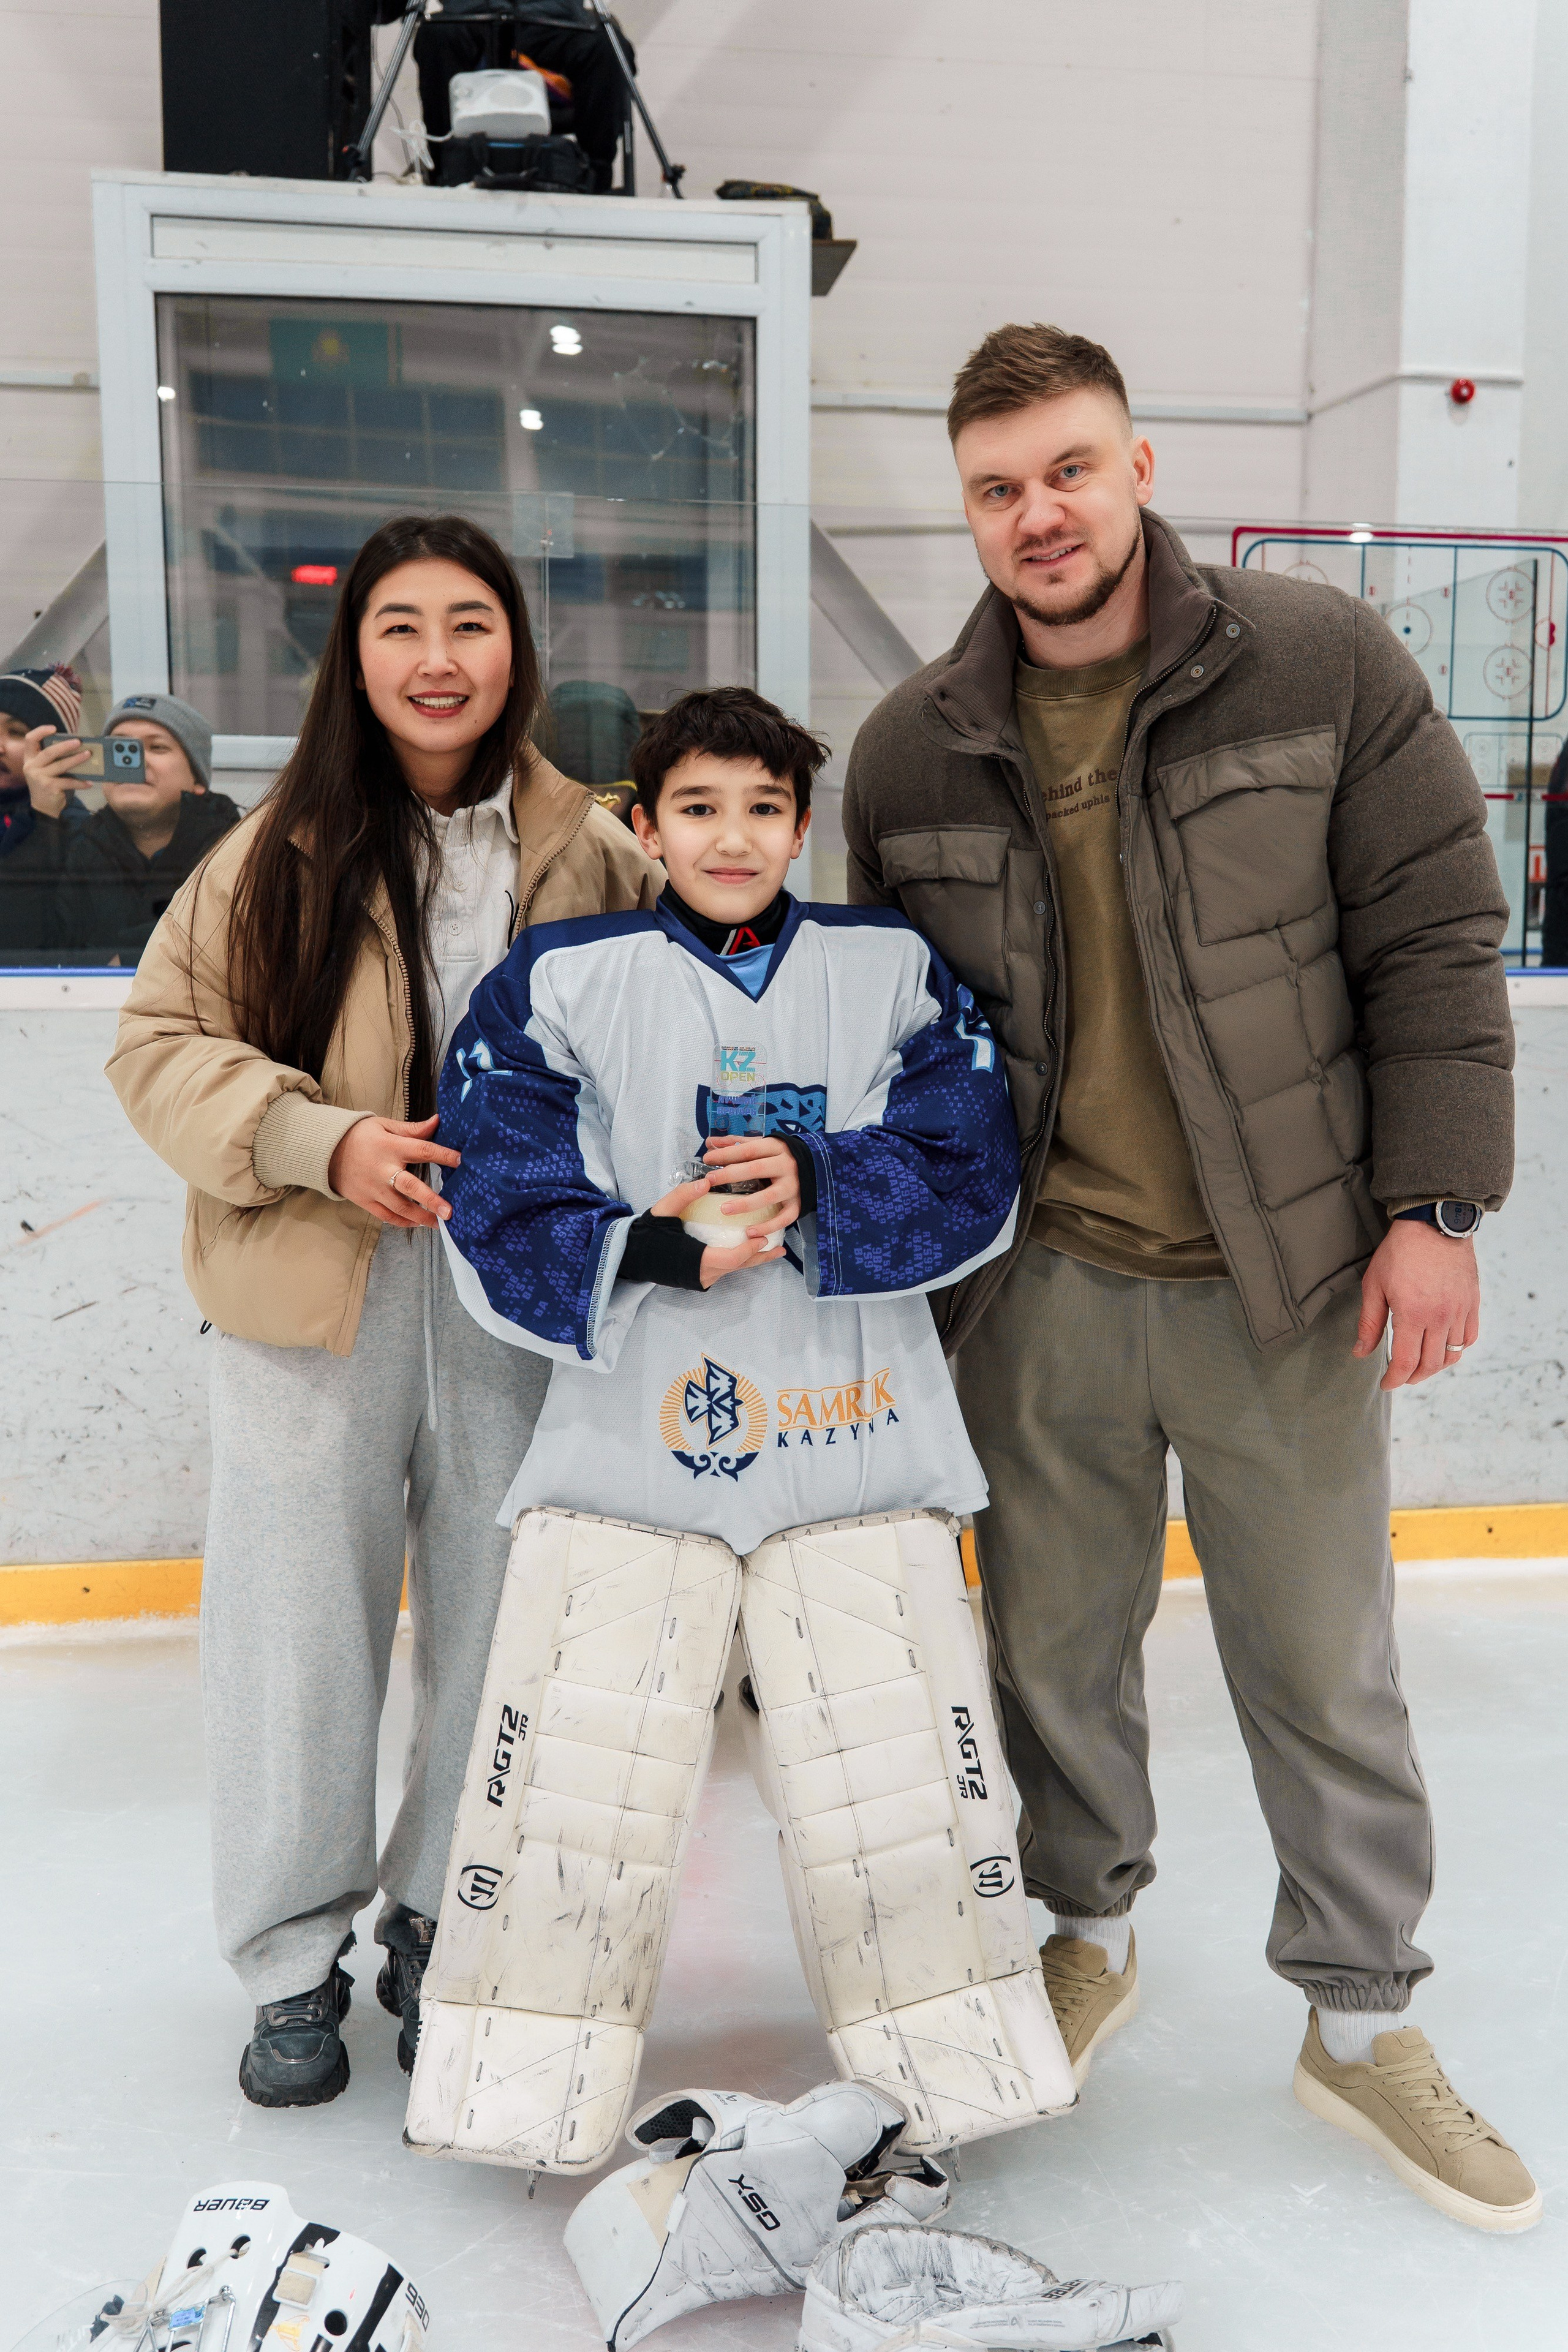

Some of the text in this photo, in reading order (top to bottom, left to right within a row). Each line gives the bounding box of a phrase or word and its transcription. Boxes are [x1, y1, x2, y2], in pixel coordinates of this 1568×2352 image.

[1087, 768, 1118, 787] the
[721, 1050, 756, 1072] KZ
[720, 1071, 756, 1082] OPEN
[518, 1714, 529, 1741] JR
[956, 1774, 968, 1799] JR
[193, 2198, 270, 2212] BAUER
[404, 2282, 430, 2333] 930
